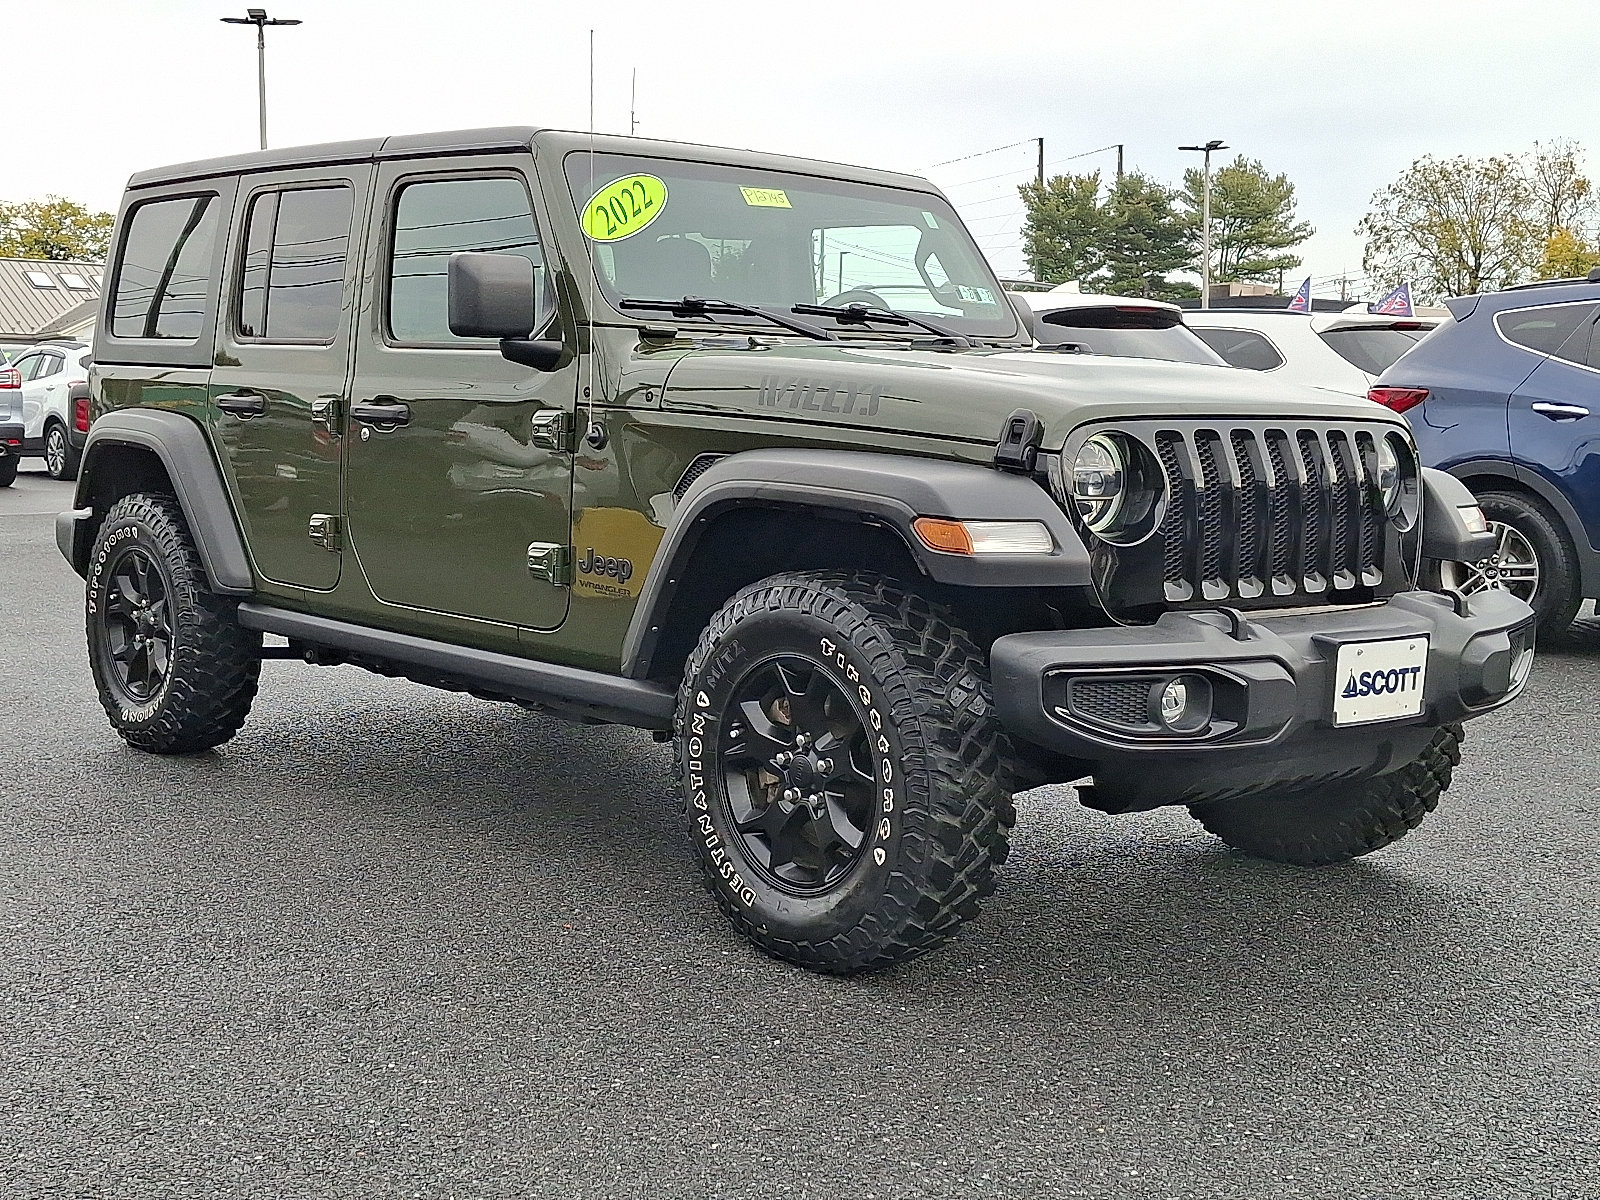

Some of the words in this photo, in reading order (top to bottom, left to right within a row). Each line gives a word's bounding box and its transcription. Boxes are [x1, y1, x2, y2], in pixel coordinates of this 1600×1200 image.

[596, 180, 654, 236] 2022
[758, 374, 890, 416] WILLYS
[578, 547, 633, 585] Jeep
[579, 580, 631, 598] WRANGLER
[1358, 666, 1421, 697] SCOTT
[688, 713, 757, 907] DESTINATION
